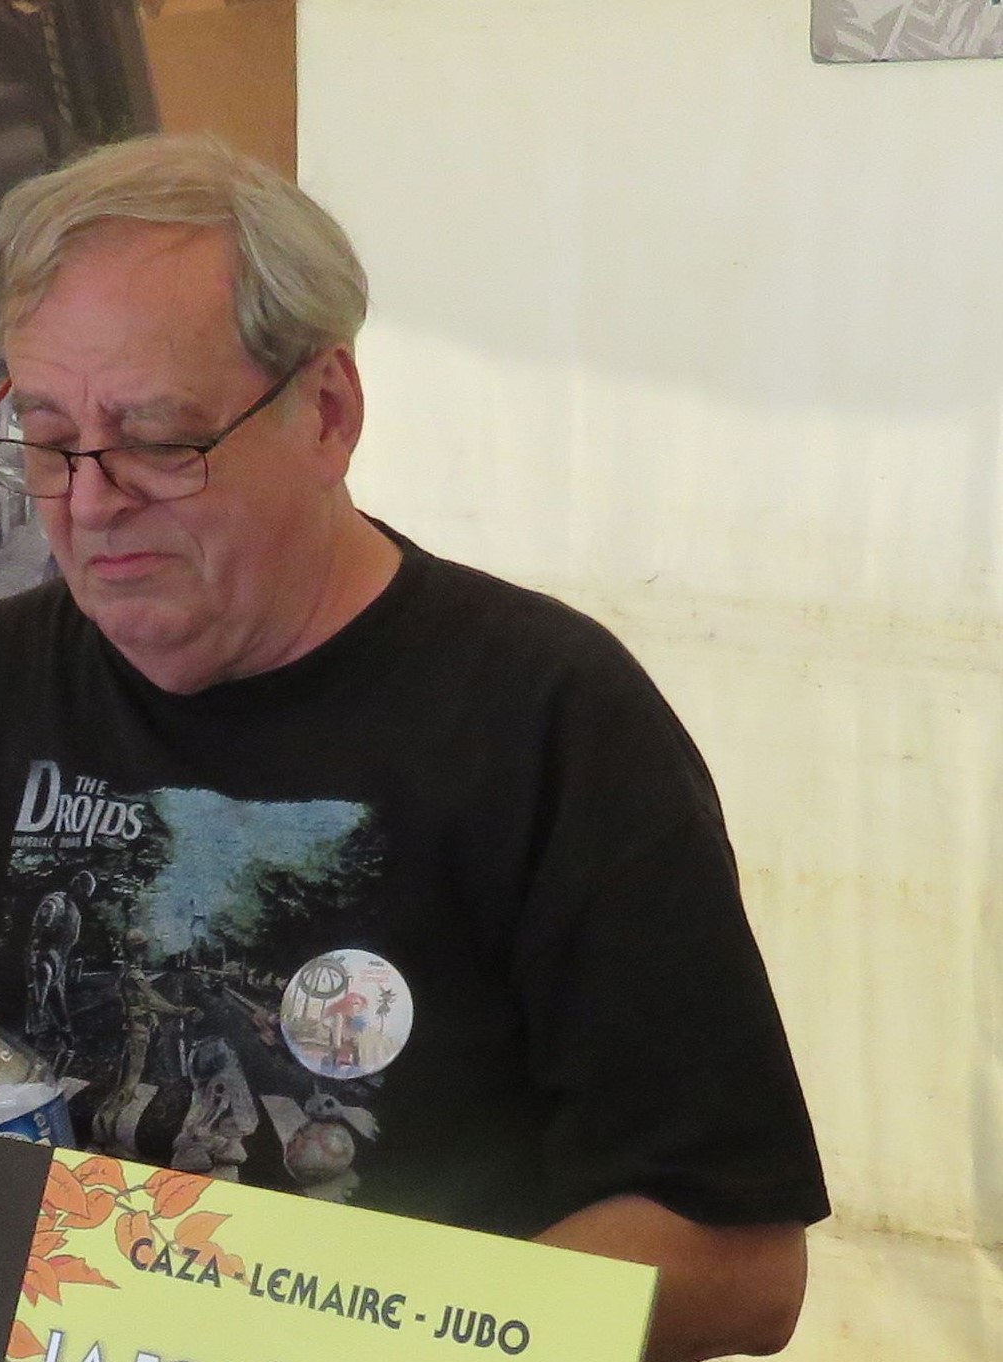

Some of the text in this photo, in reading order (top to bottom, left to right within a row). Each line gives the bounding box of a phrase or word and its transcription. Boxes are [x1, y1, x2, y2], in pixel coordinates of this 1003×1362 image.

[14, 759, 145, 847] DROIDS
[74, 775, 109, 797] THE
[129, 1238, 221, 1288] CAZA
[248, 1262, 406, 1330] LEMAIRE
[434, 1306, 530, 1355] JUBO
